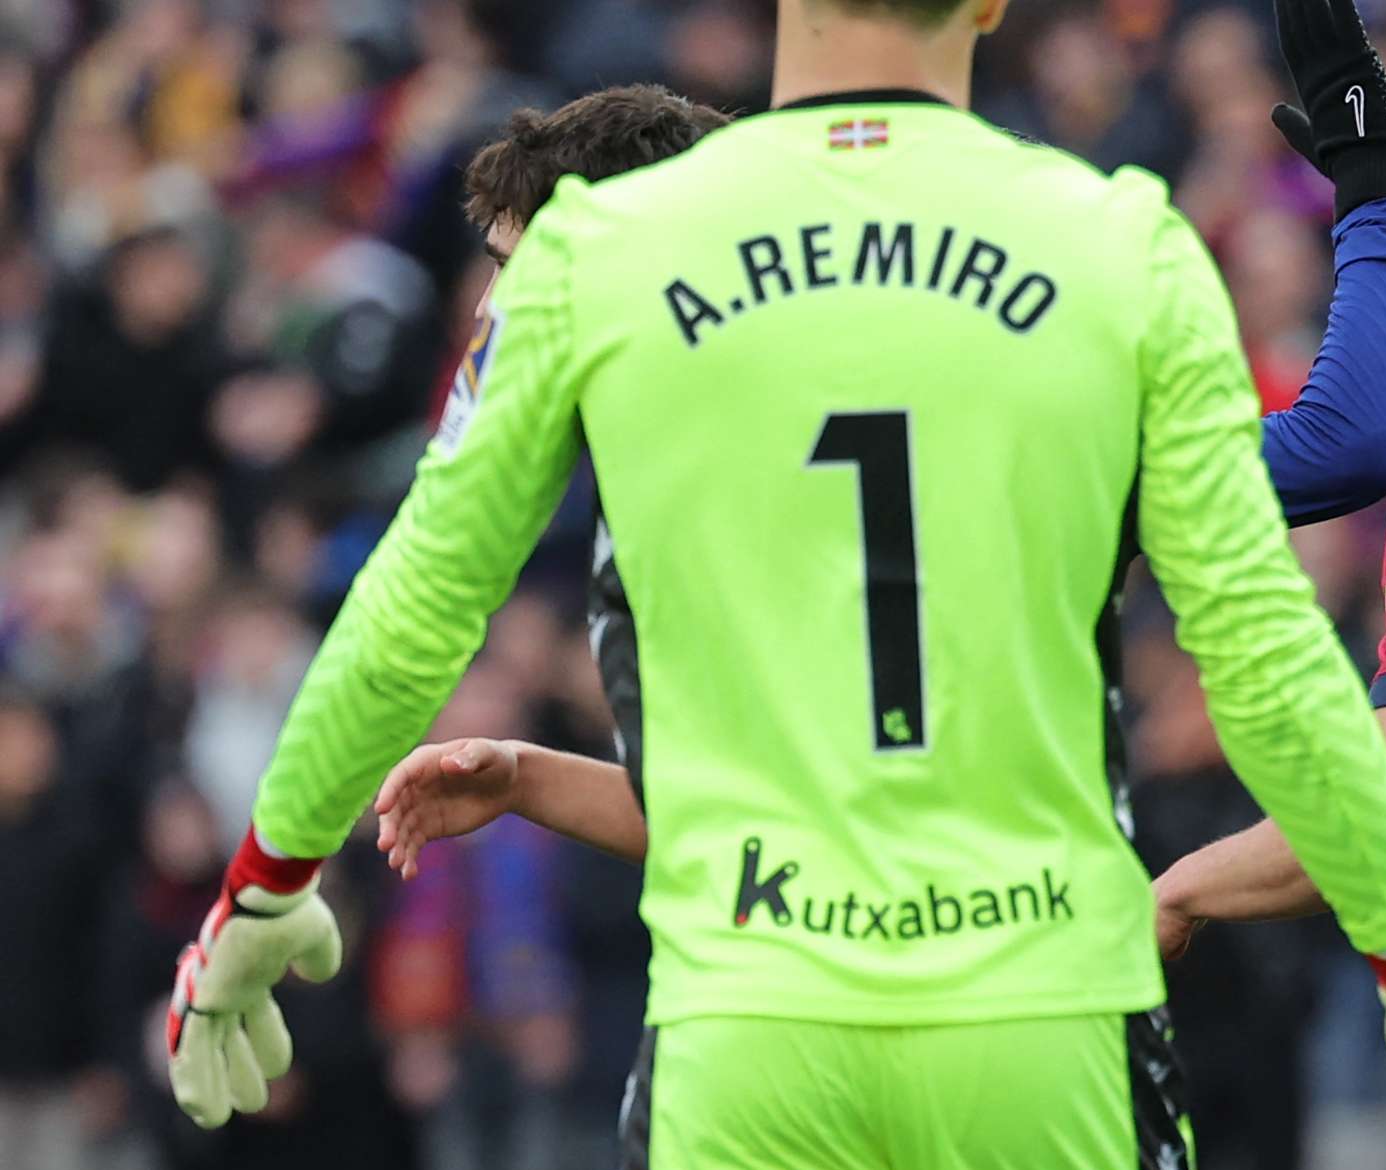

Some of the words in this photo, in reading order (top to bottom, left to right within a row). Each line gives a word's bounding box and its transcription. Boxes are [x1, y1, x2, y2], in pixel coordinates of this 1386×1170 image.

[663, 222, 1056, 348] A.REMIRO
[806, 410, 925, 748] 1
[733, 836, 1074, 940] Kutxabank
